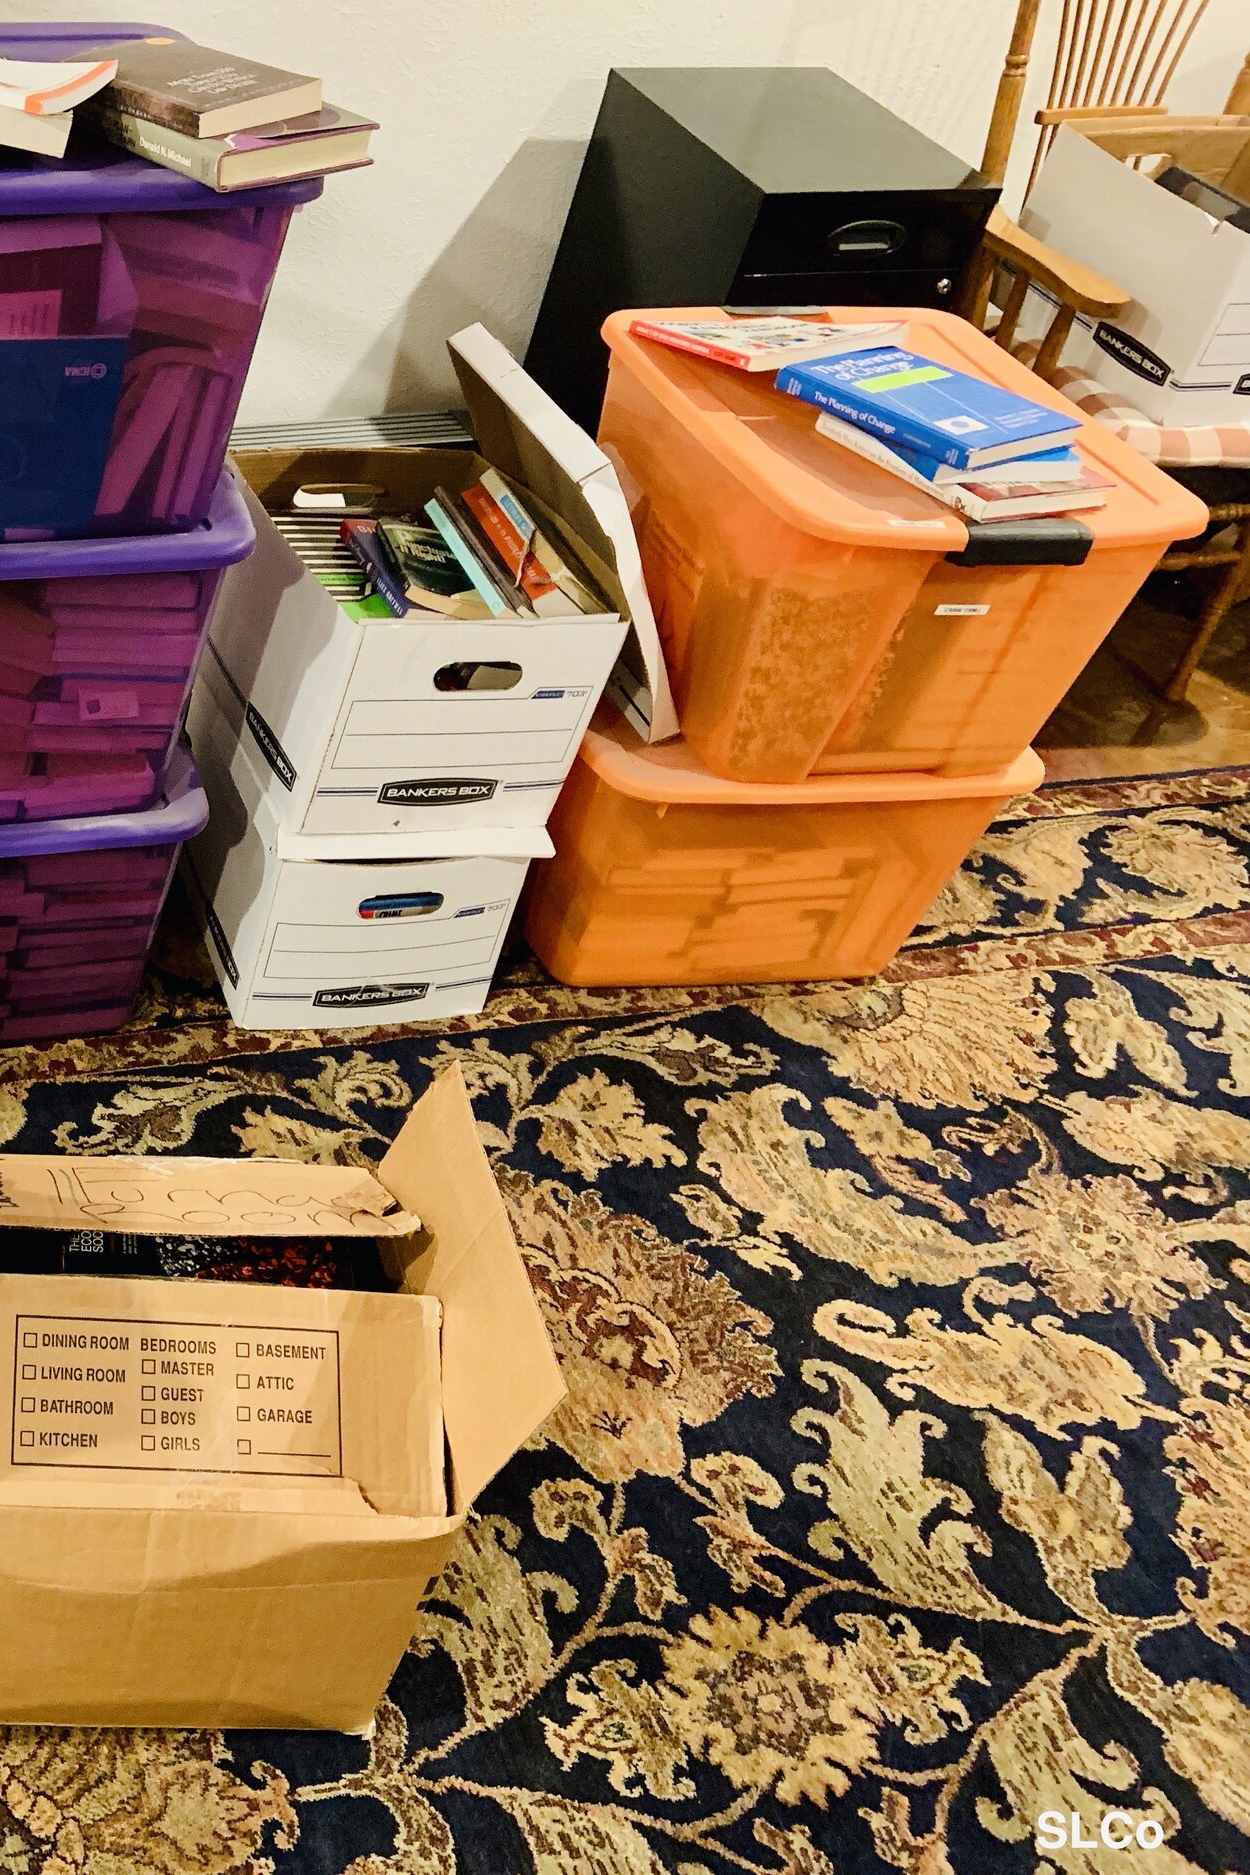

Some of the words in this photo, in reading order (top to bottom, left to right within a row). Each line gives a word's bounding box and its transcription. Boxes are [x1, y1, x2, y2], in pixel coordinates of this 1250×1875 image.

[139, 136, 161, 154] Donald
[160, 145, 168, 157] N.
[167, 149, 192, 167] Michael
[1099, 329, 1143, 365] BANKERS
[1141, 358, 1165, 379] BOX
[810, 361, 844, 377] The
[840, 351, 915, 373] Planning
[835, 368, 852, 381] of
[849, 359, 915, 380] Change
[814, 390, 829, 406] The
[827, 398, 860, 422] Planning
[858, 410, 869, 422] of
[867, 413, 897, 436] Change
[248, 710, 278, 761] BANKERS
[275, 754, 293, 783] BOX
[386, 787, 457, 798] BANKERS
[459, 785, 492, 796] BOX
[320, 990, 385, 1003] BANKERS
[387, 987, 424, 999] BOX
[69, 1233, 80, 1252] THE
[42, 1333, 87, 1349] DINING
[90, 1336, 129, 1350] ROOM
[141, 1338, 217, 1354] BEDROOMS
[256, 1344, 326, 1360] BASEMENT
[41, 1366, 83, 1381] LIVING
[86, 1368, 126, 1382] ROOM
[161, 1361, 214, 1376] MASTER
[257, 1375, 295, 1391] ATTIC
[161, 1387, 205, 1402] GUEST
[40, 1399, 114, 1415] BATHROOM
[161, 1411, 196, 1426] BOYS
[257, 1408, 313, 1424] GARAGE
[39, 1432, 98, 1448] KITCHEN
[161, 1437, 200, 1451] GIRLS
